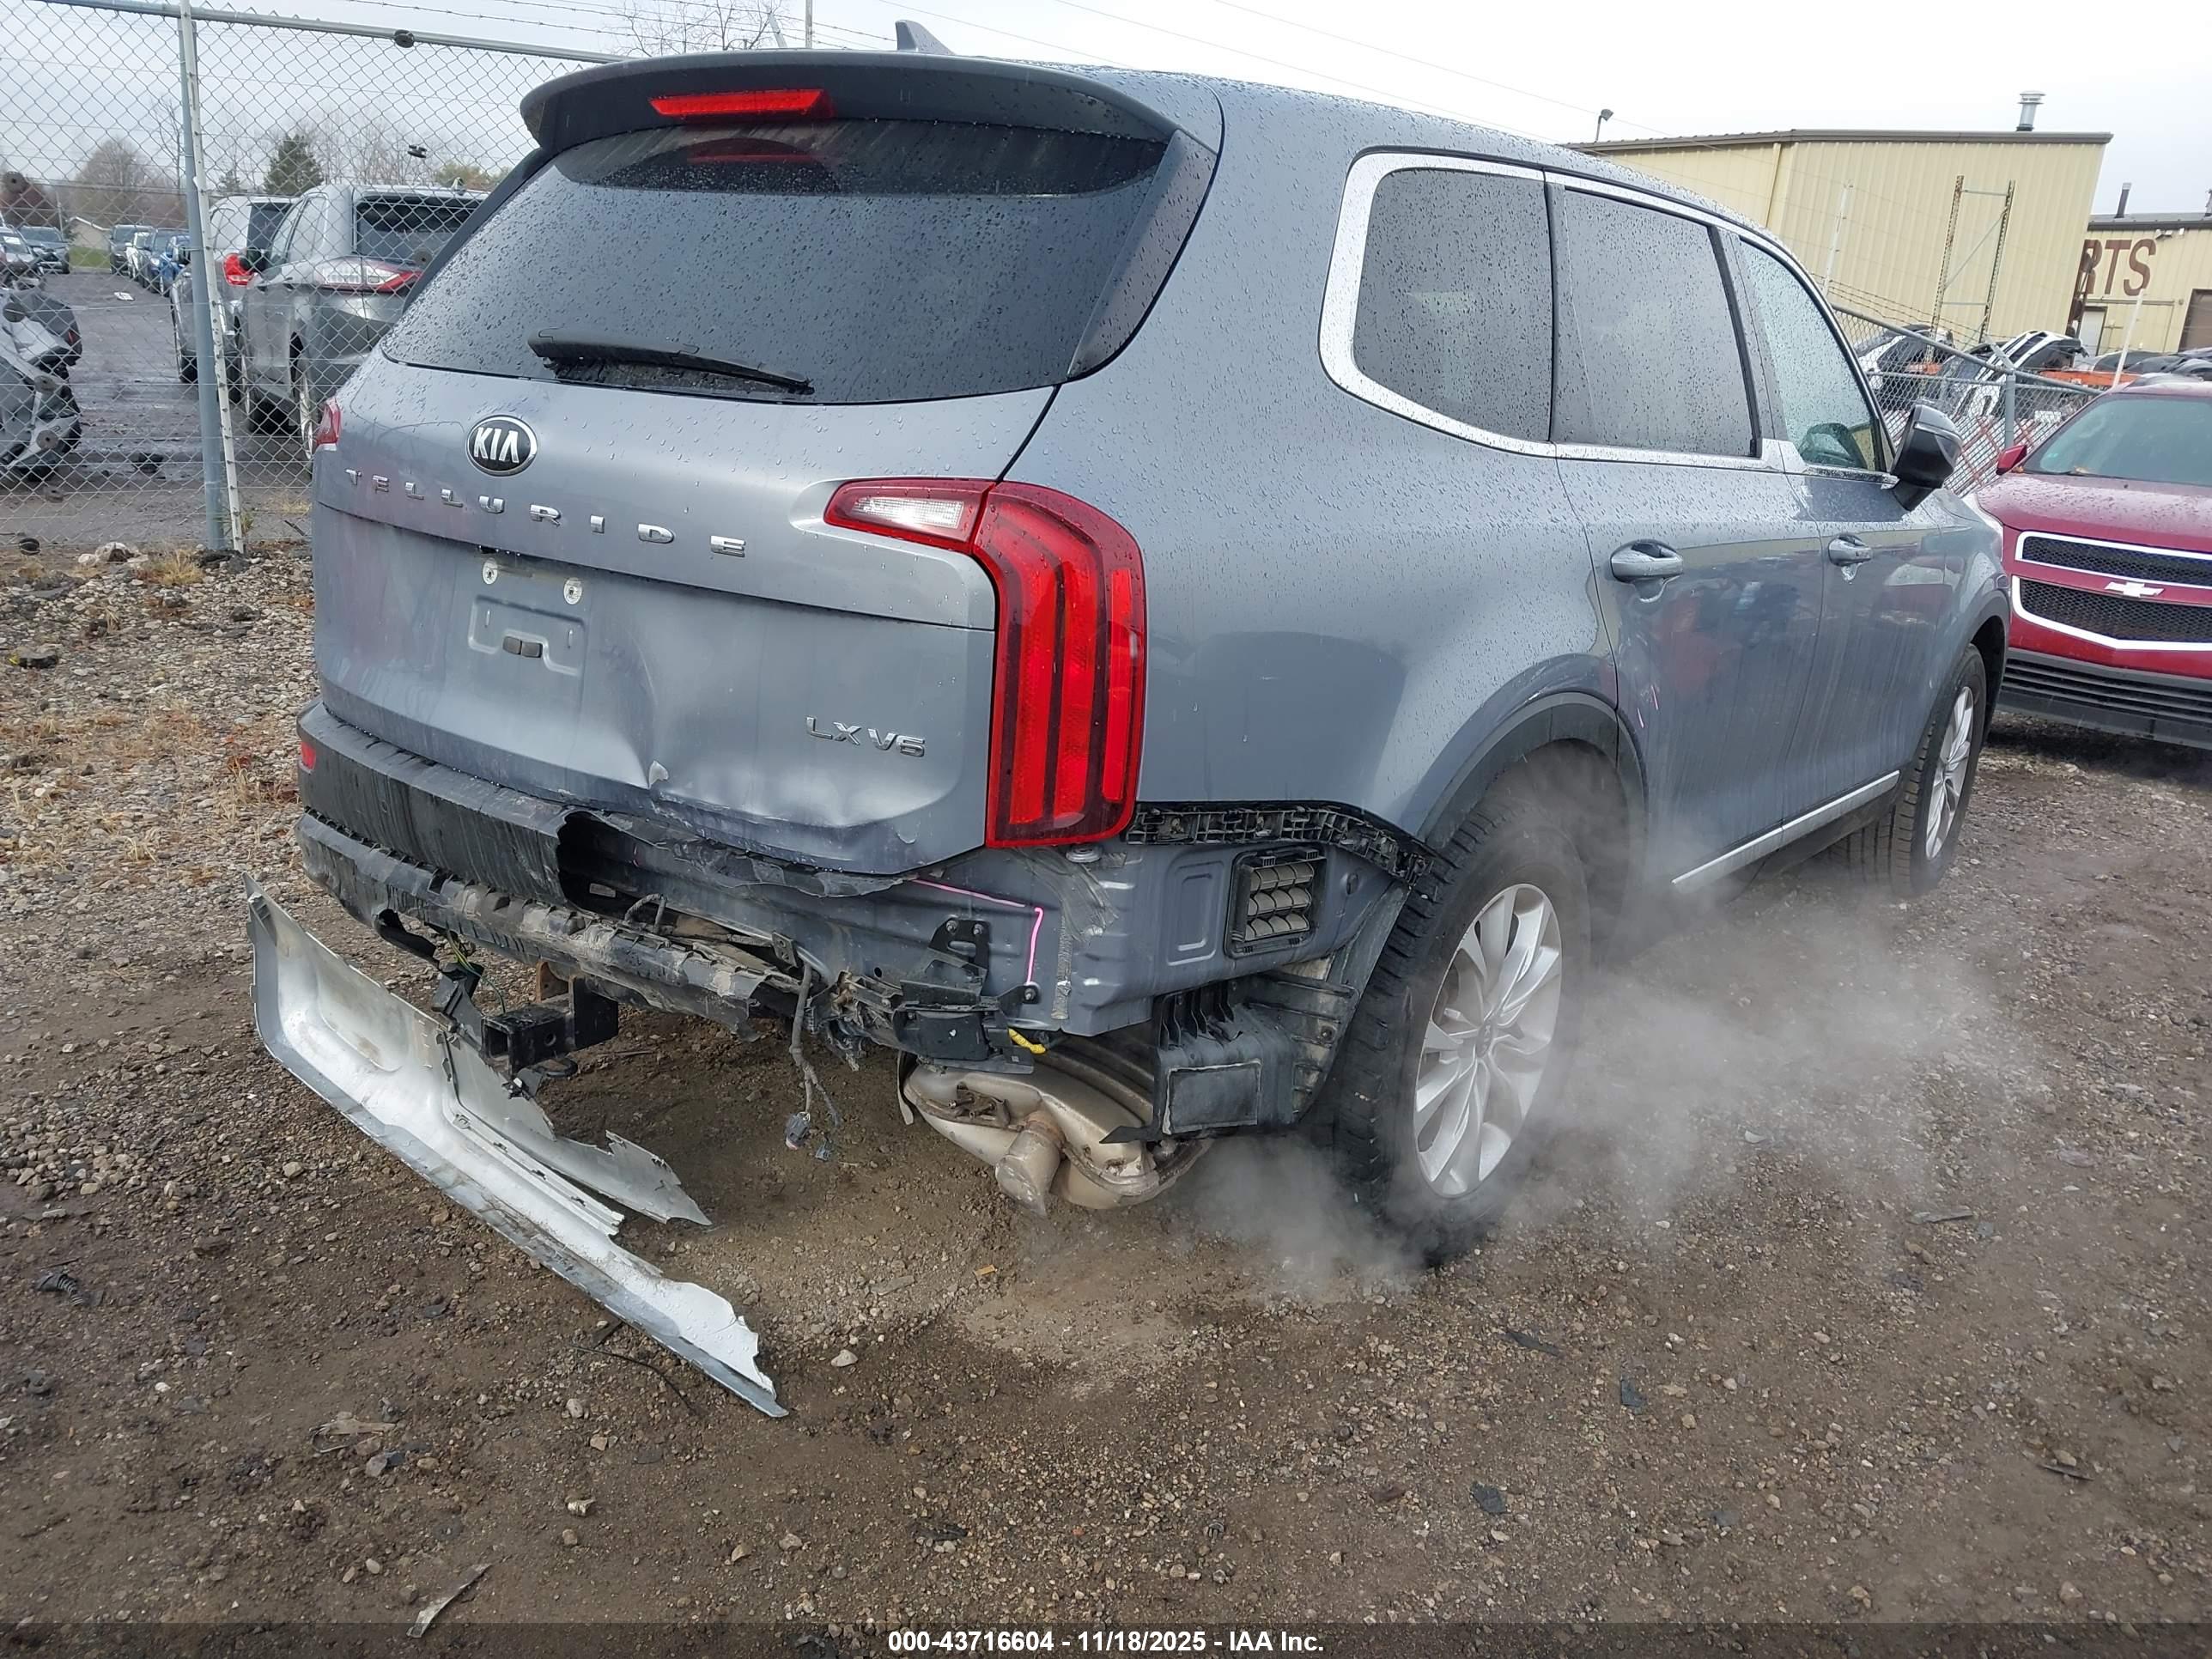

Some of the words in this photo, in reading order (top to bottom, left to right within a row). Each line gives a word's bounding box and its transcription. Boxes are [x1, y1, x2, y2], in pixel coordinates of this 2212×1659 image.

[473, 427, 519, 463] KIA
[345, 468, 745, 557] TELLURIDE
[806, 716, 861, 745] LX
[867, 728, 925, 757] V6
